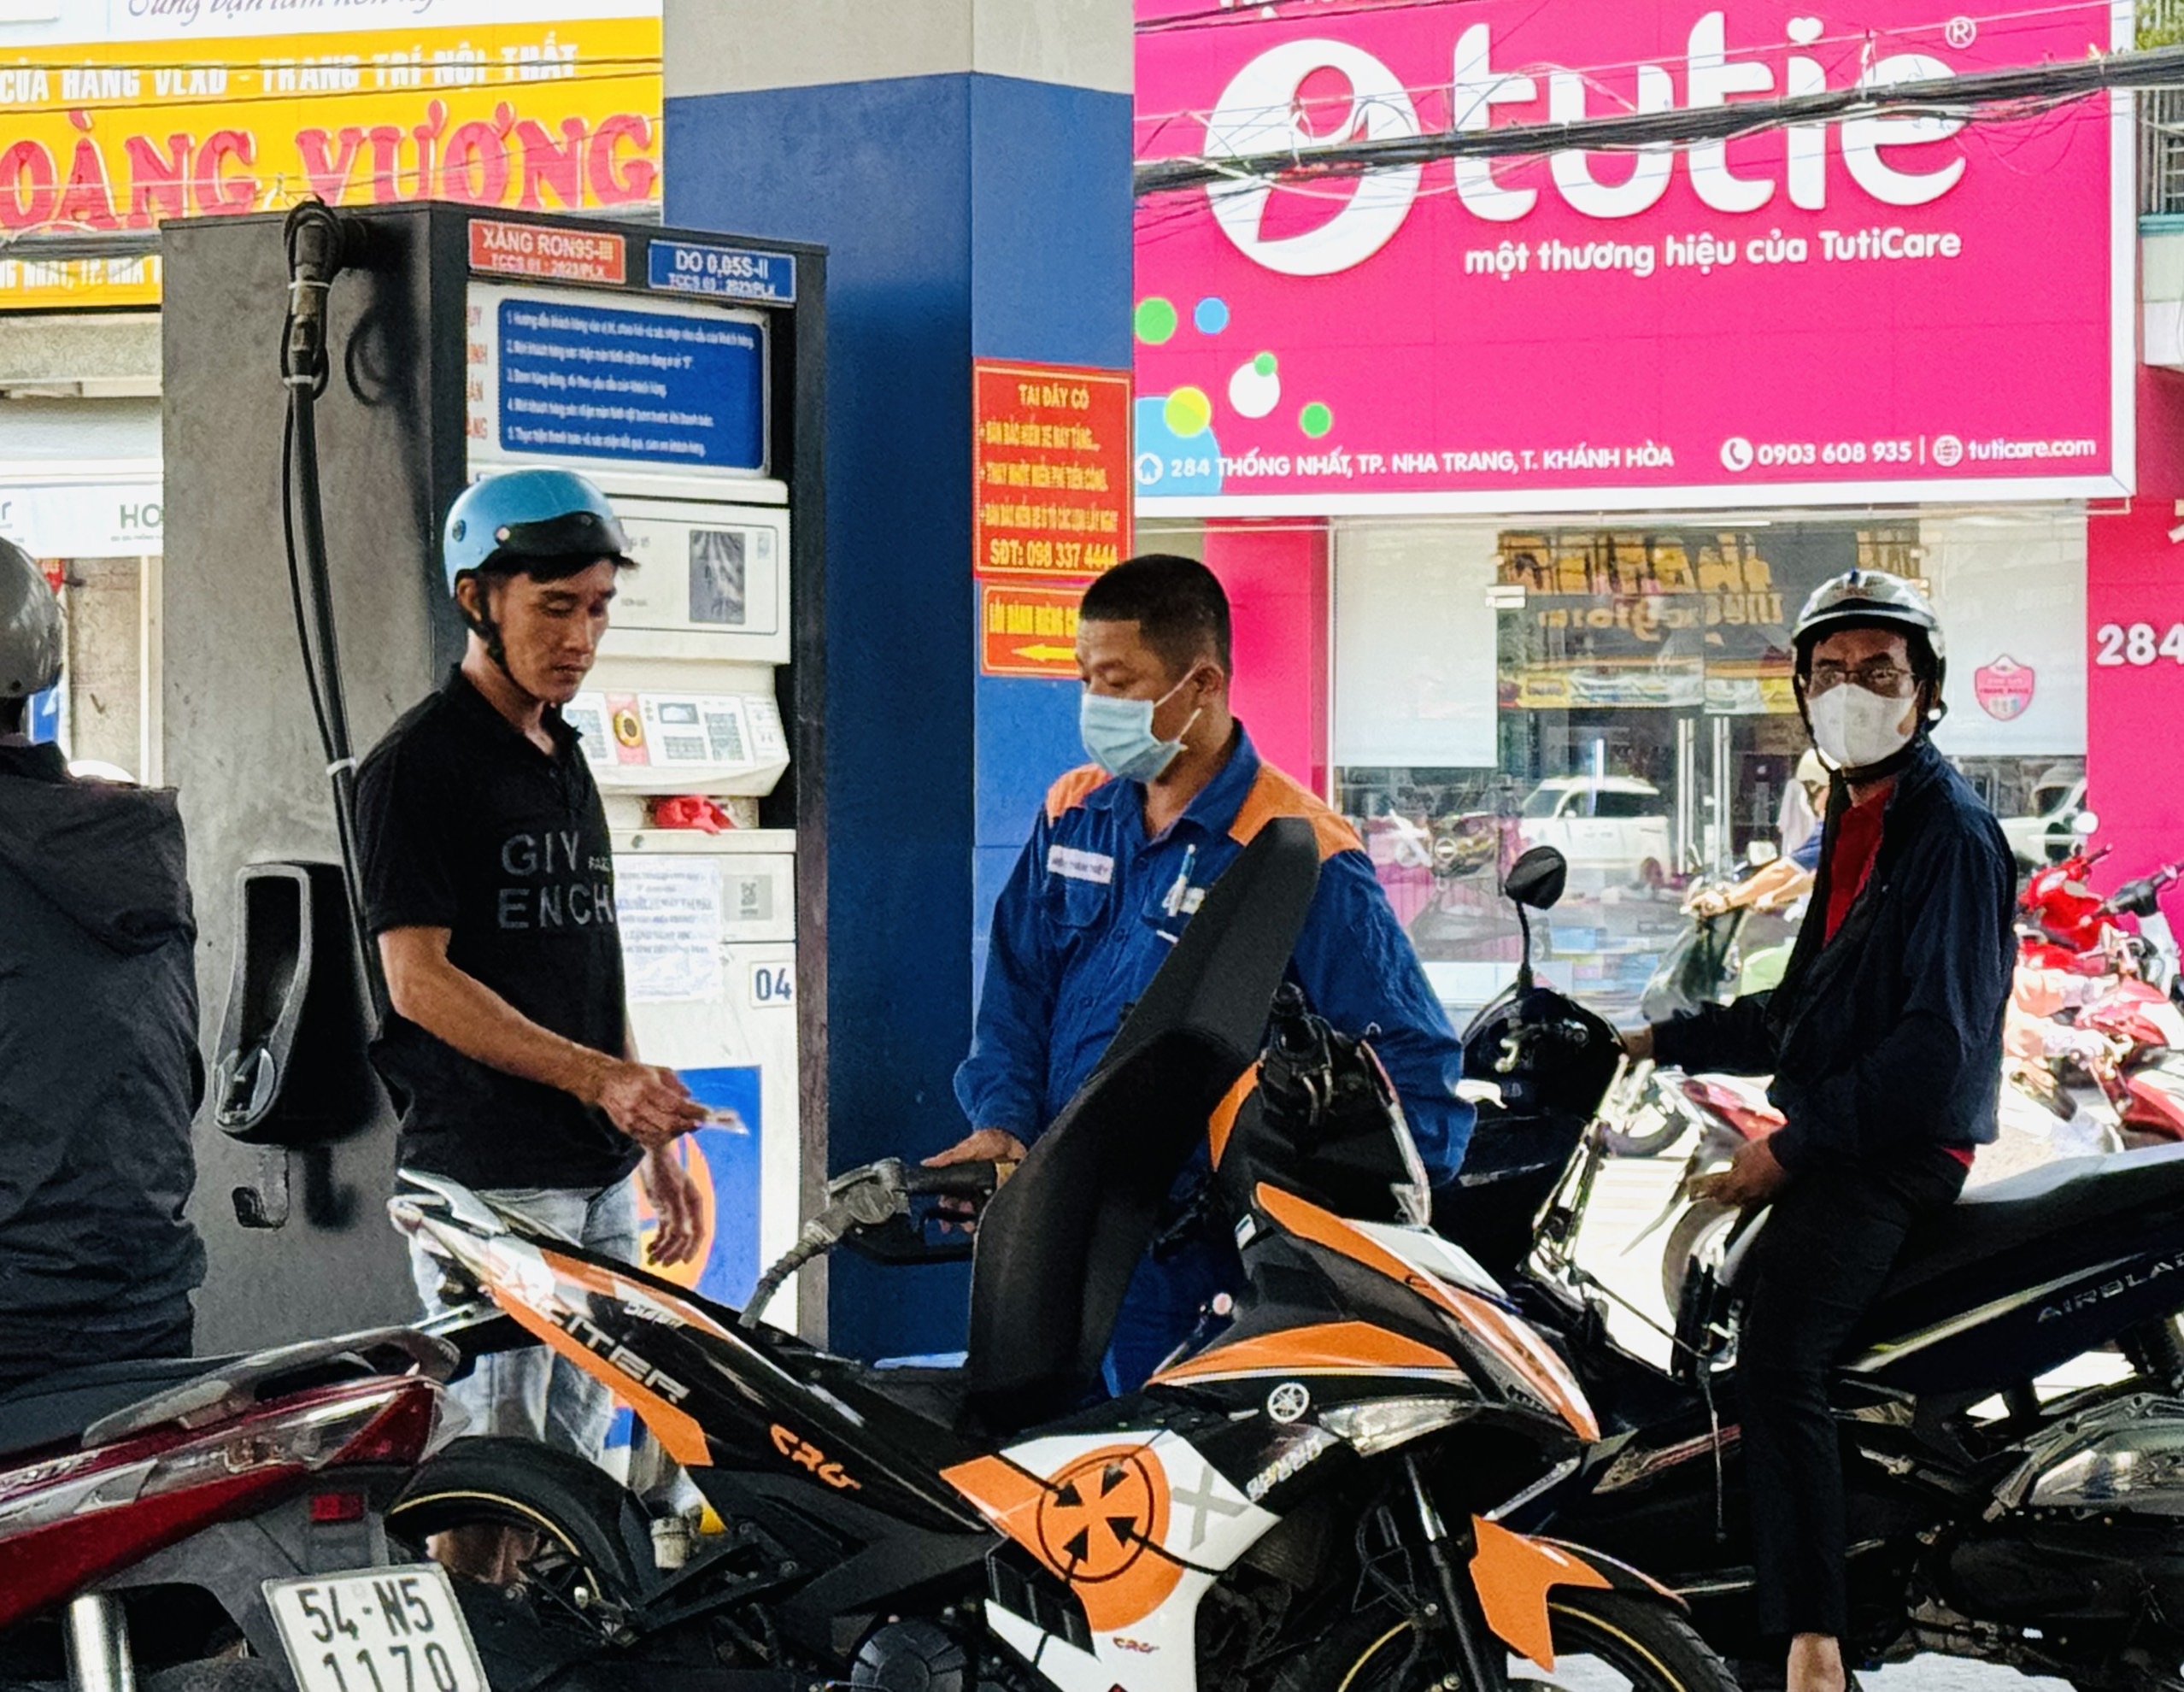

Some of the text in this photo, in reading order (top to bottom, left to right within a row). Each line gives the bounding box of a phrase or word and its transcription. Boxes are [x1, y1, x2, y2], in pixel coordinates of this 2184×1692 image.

[62, 58, 140, 101] HÀNG
[154, 62, 228, 97] VLXD
[259, 55, 360, 92] TRANG
[373, 44, 422, 86] TRÍ
[434, 40, 485, 92] NỘI
[502, 30, 578, 81] THẤT
[1453, 10, 1966, 222] tutie
[295, 98, 659, 210] VƯƠNG
[674, 249, 704, 273] DO
[1465, 226, 1961, 280] một thương hiệu của TutiCare
[1170, 439, 1674, 480] 284 THỐNG NHẤT, TP. NHA TRANG, T. KHÁNH HÒA
[1757, 439, 1913, 467] 0903 608 935
[1968, 435, 2097, 461] tuticare.com
[2096, 622, 2184, 666] 284
[501, 830, 581, 876] GIV
[755, 967, 792, 1002] 04
